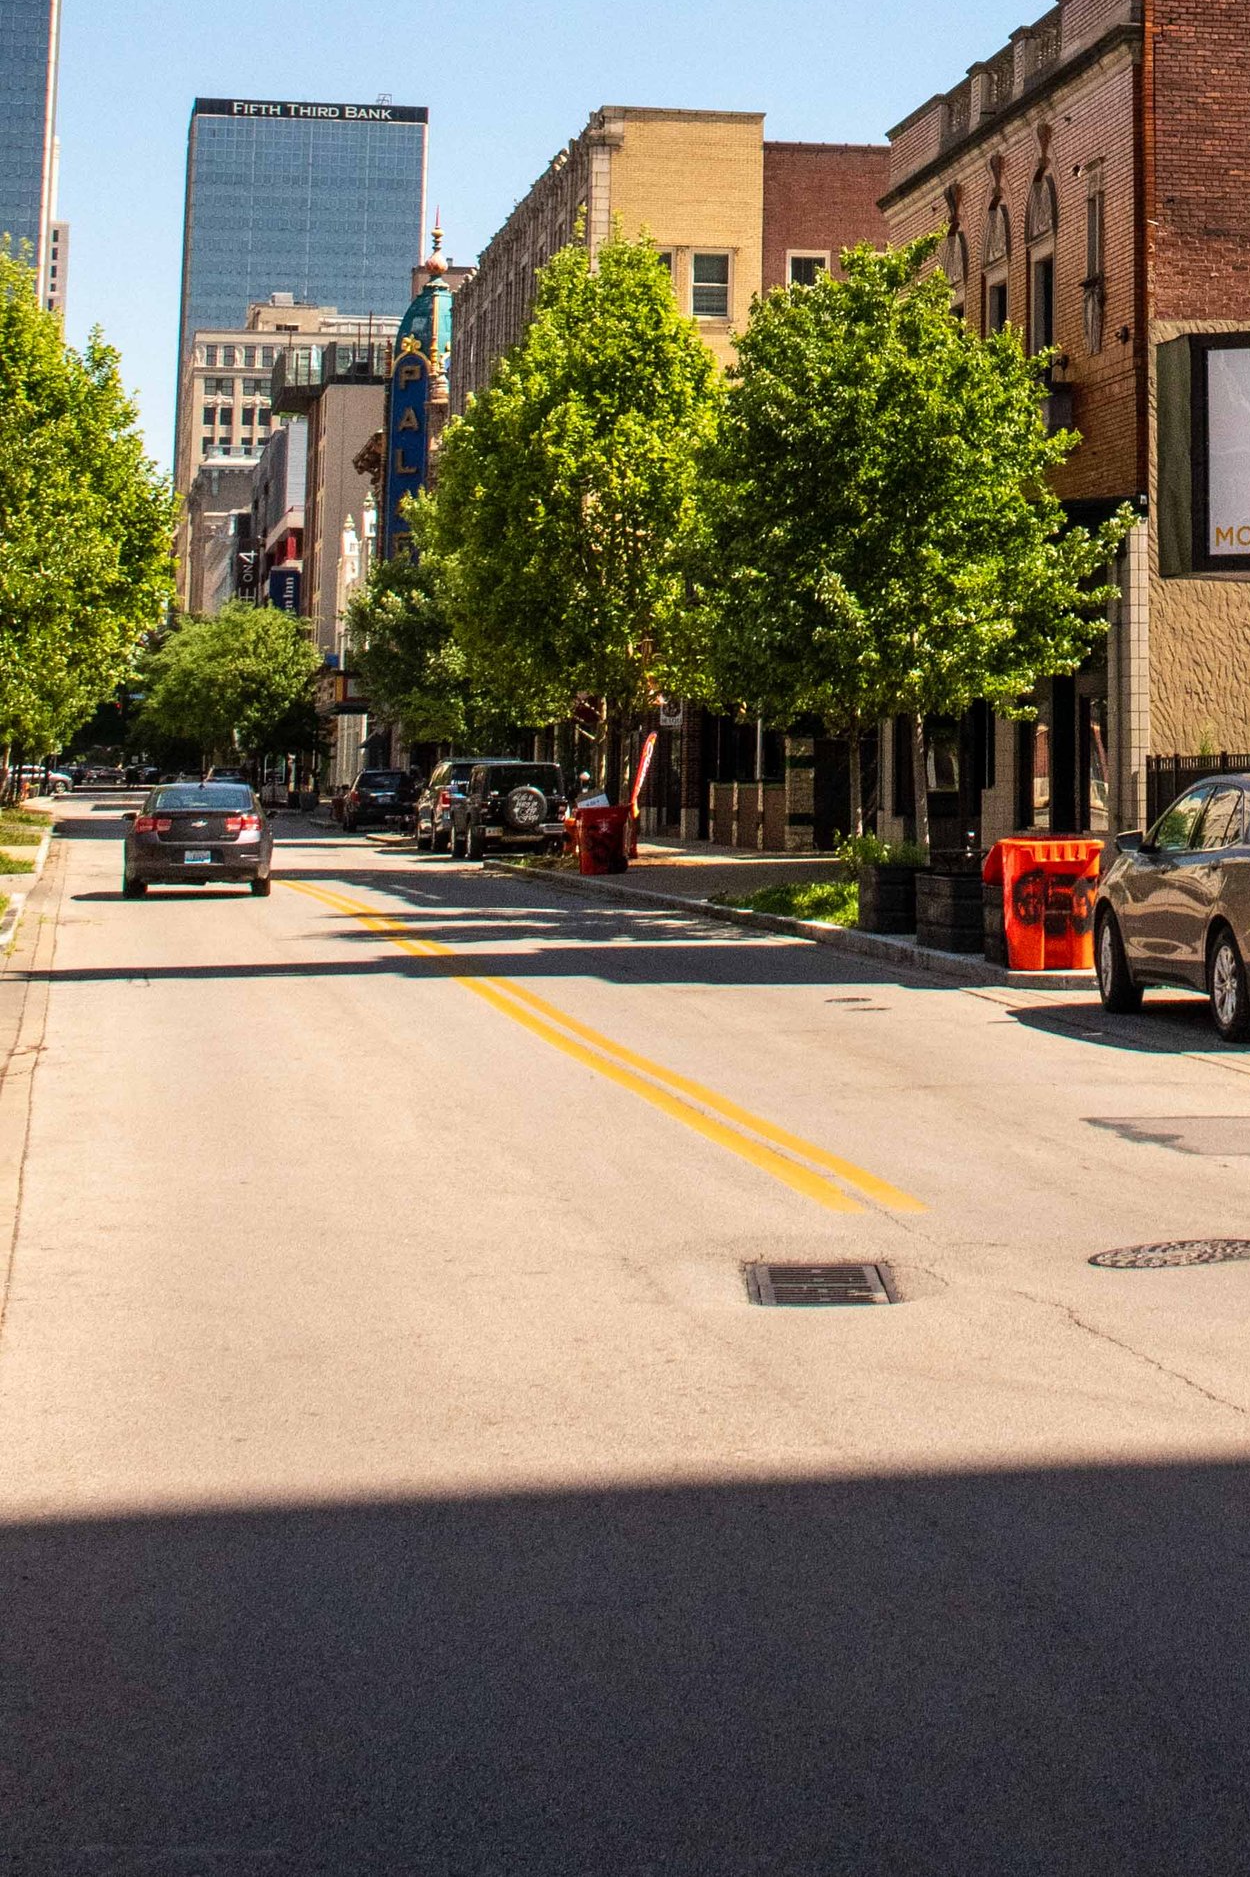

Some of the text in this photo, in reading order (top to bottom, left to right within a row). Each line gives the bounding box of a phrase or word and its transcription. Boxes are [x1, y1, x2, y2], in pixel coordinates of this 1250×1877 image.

[232, 102, 393, 120] FIFTH THIRD BANK
[283, 577, 294, 598] Inn
